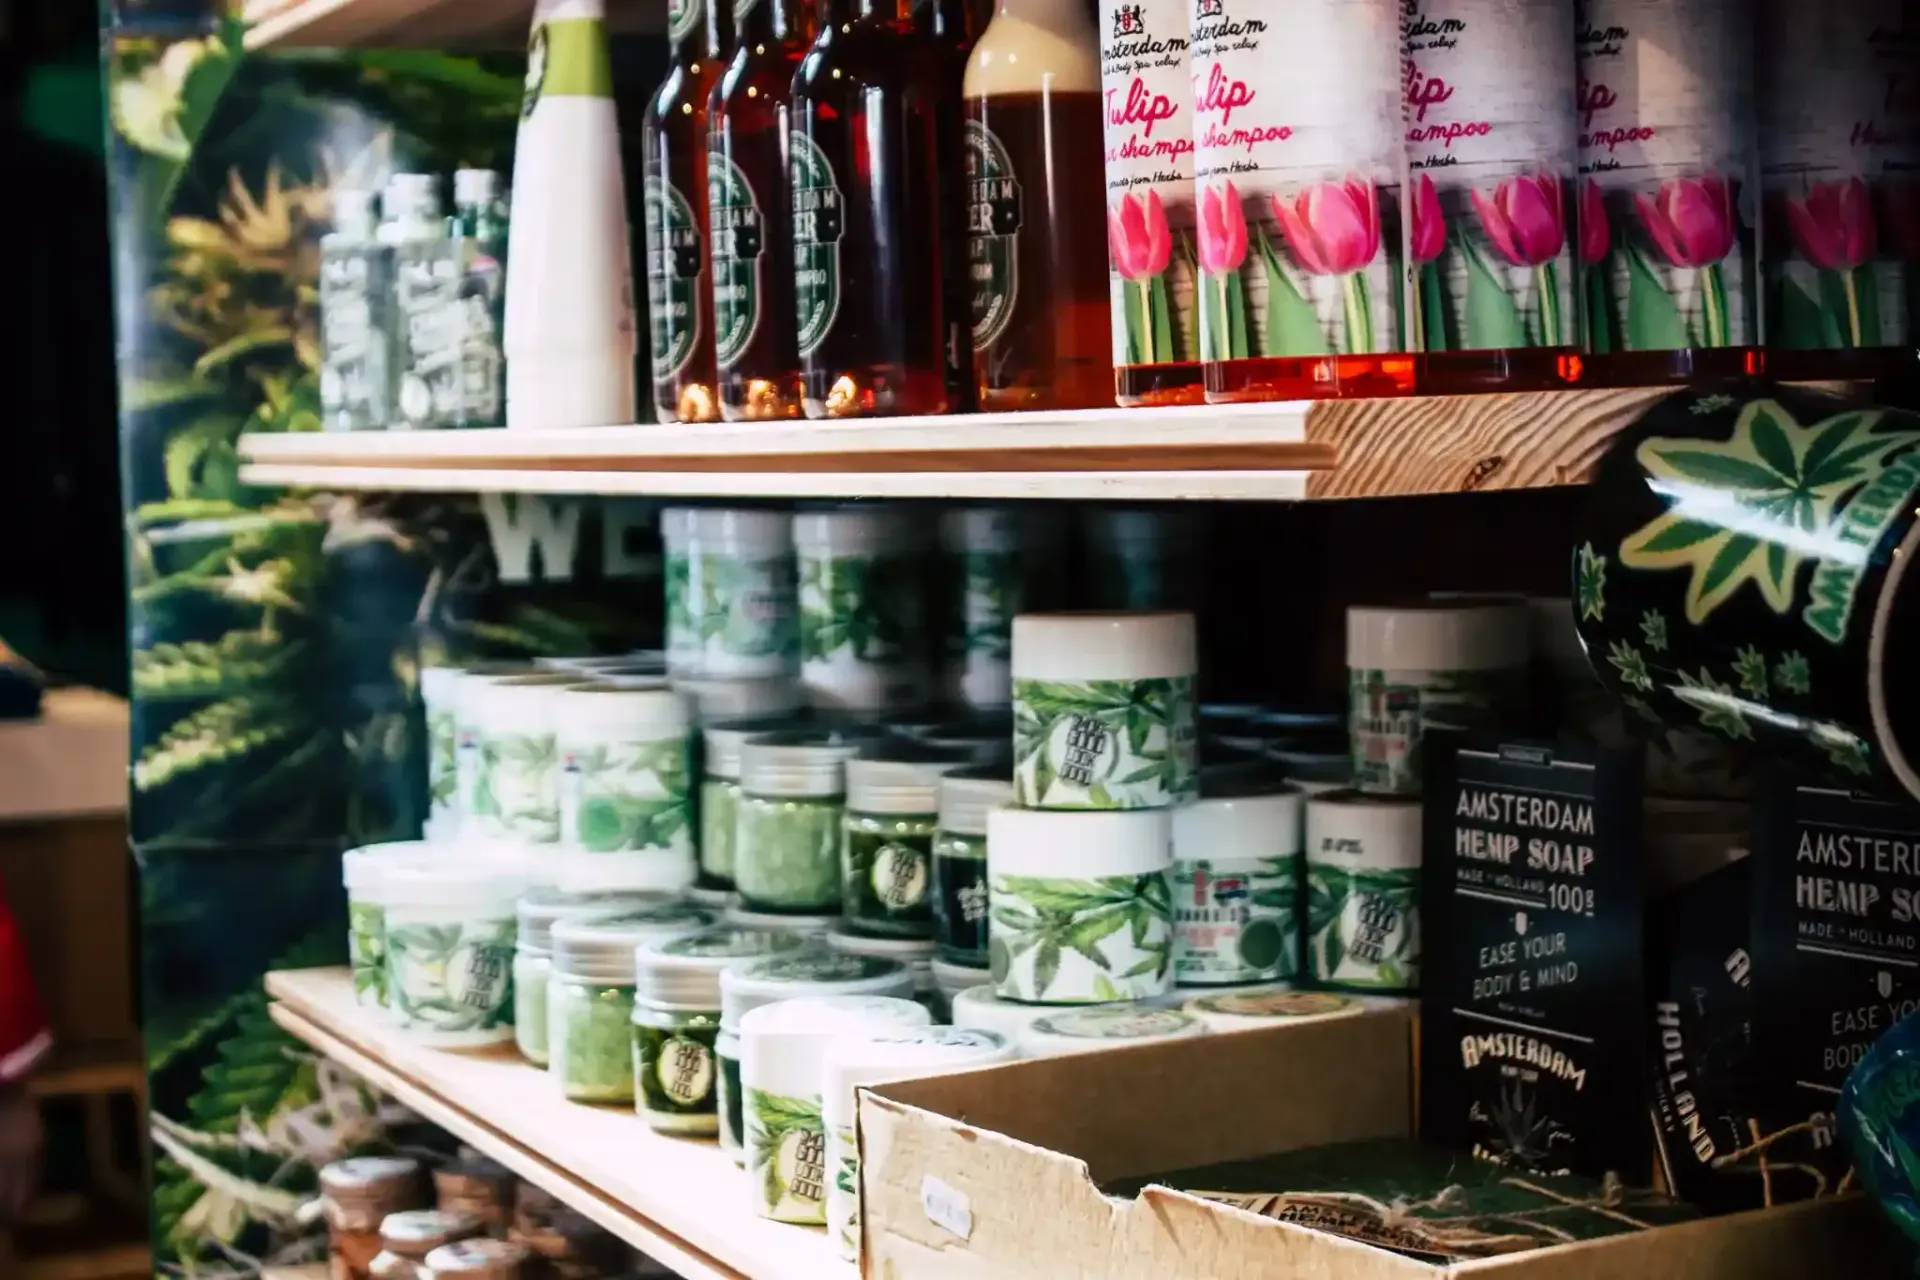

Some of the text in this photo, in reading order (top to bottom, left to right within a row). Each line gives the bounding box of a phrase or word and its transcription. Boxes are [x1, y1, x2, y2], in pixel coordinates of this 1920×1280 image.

[1202, 122, 1295, 154] shampoo
[1456, 789, 1595, 836] AMSTERDAM
[1455, 827, 1595, 876] HEMP SOAP
[1796, 875, 1881, 917] HEMP
[1479, 932, 1567, 969] EASE YOUR
[1798, 921, 1916, 950] MADE HOLLAND
[1472, 961, 1578, 1000] BODY & MIND
[1831, 1004, 1880, 1036] EASE
[1460, 1032, 1587, 1092] AMSTERDAM
[1656, 1001, 1717, 1164] HOLLAND
